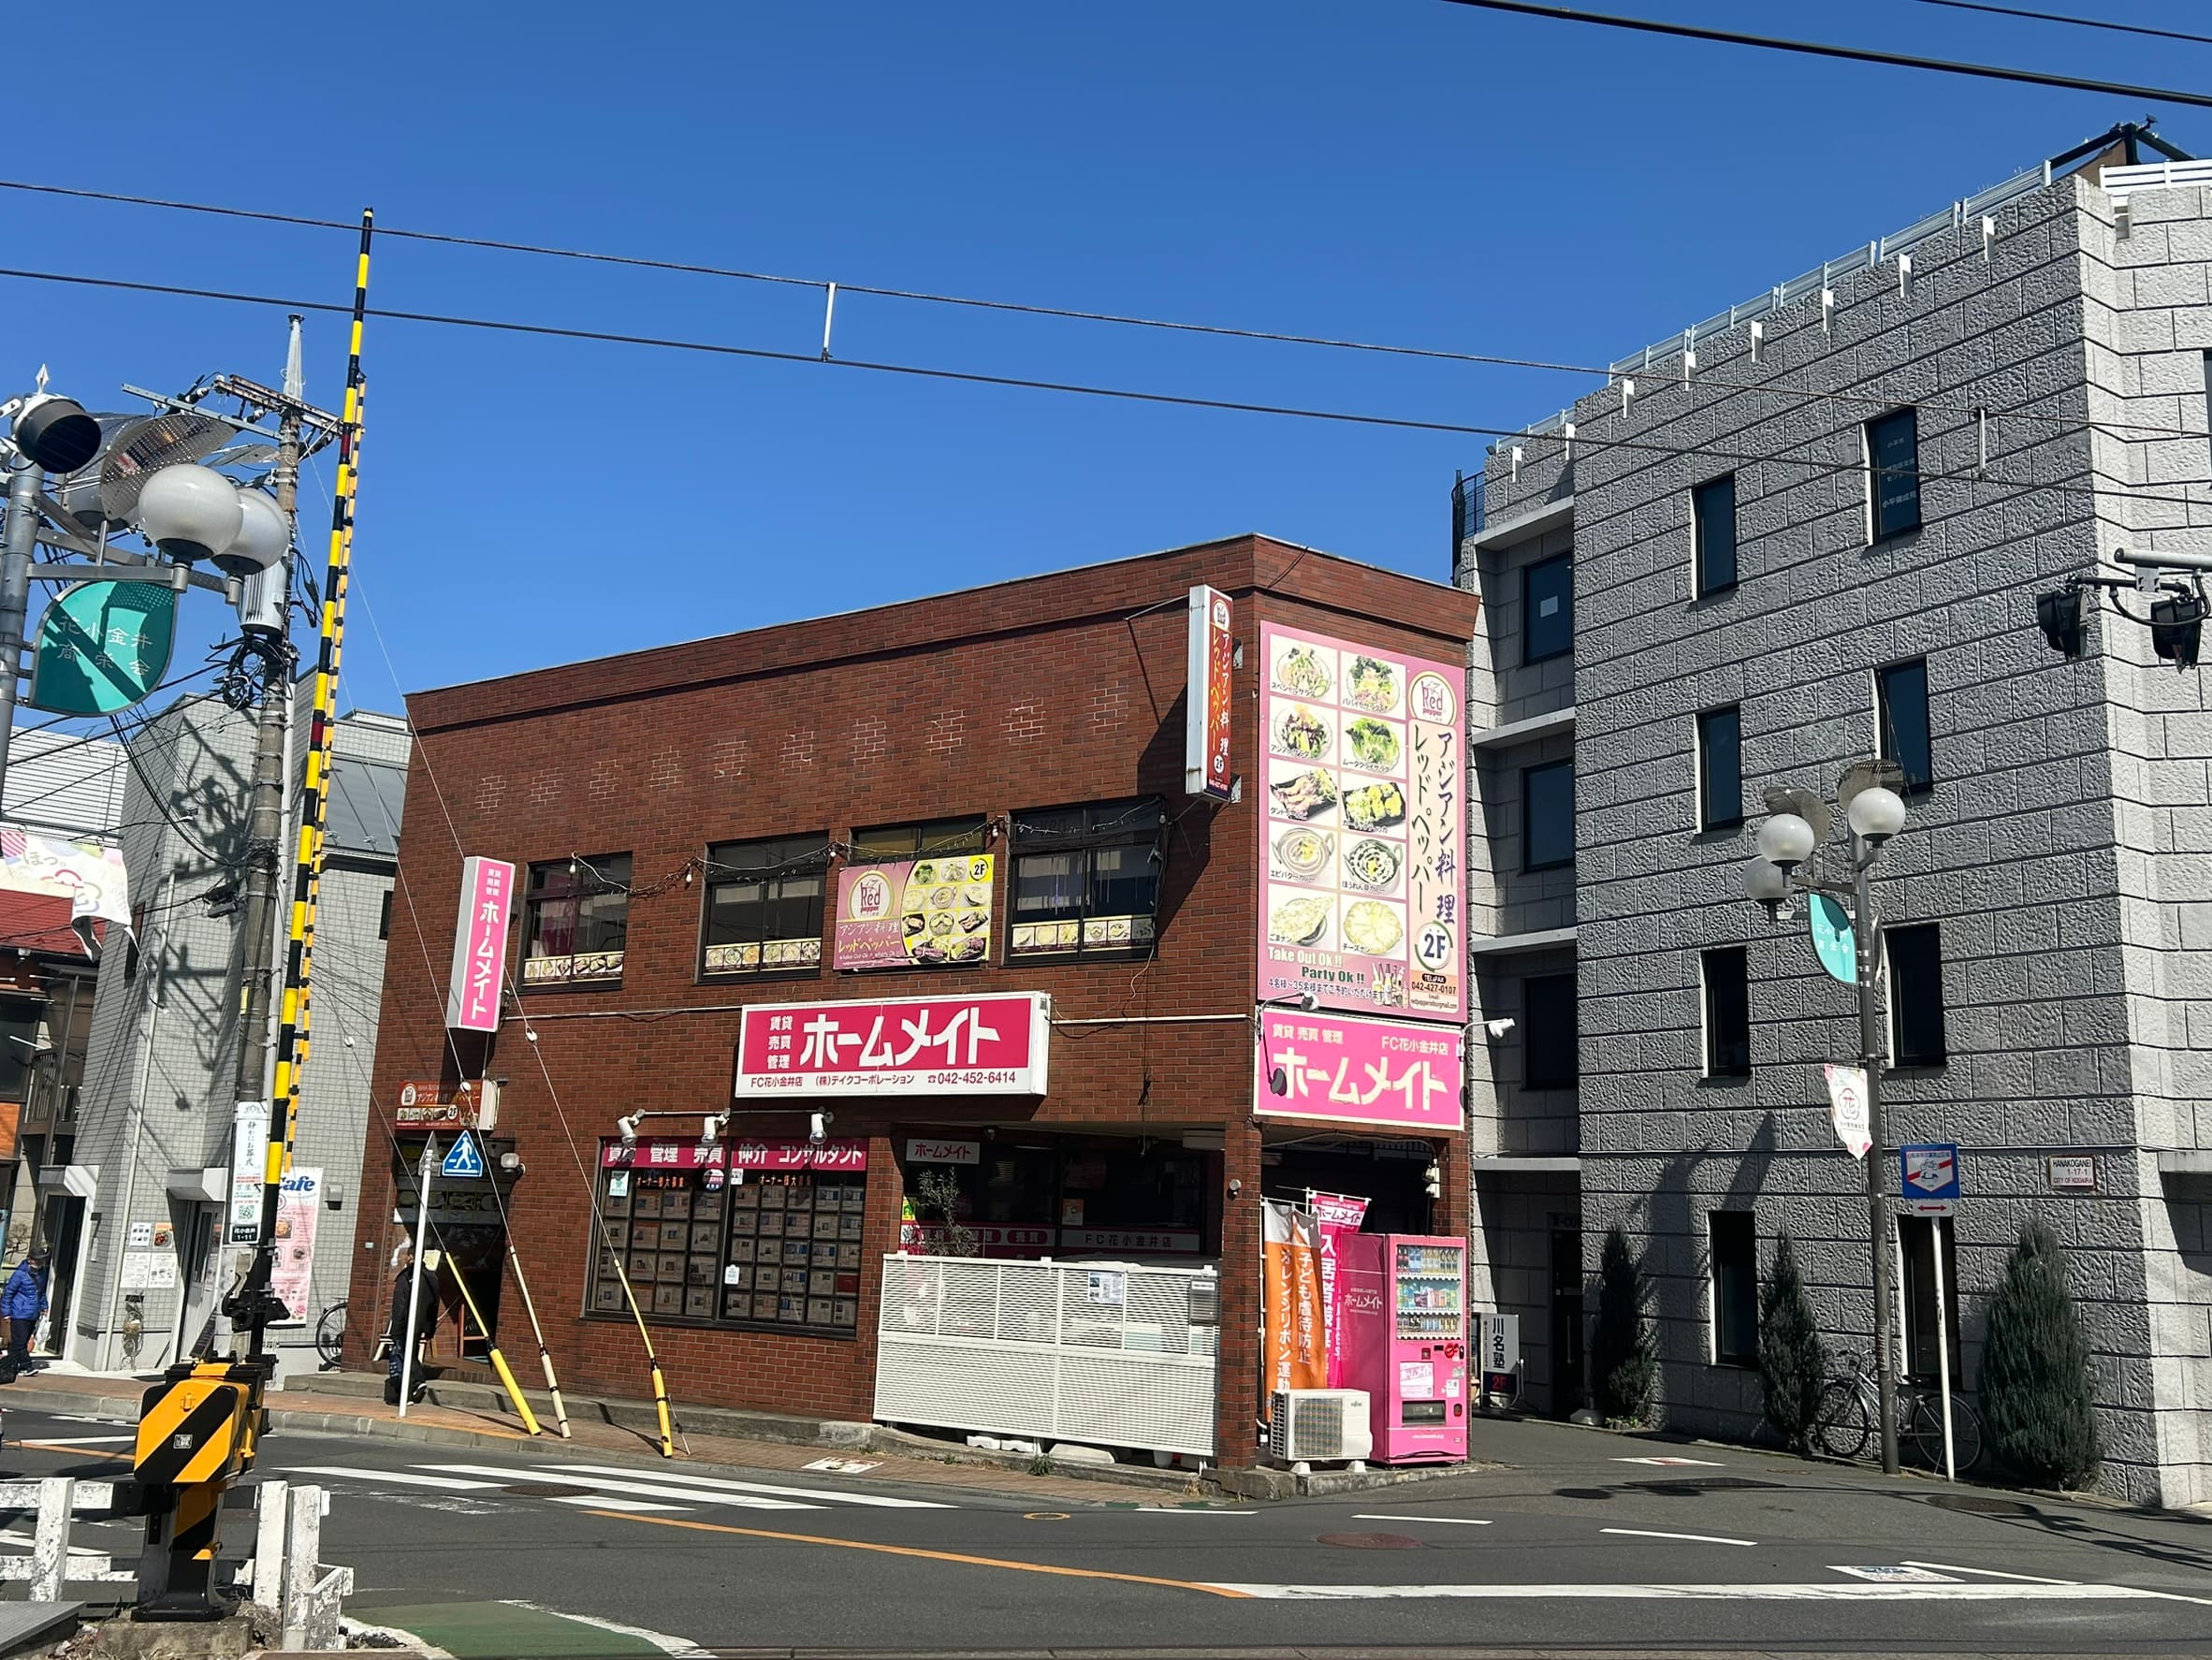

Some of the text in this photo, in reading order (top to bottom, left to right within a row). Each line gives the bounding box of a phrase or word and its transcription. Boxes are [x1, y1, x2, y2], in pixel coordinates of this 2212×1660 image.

[59, 615, 153, 649] 花小金井
[57, 643, 151, 676] 商栄会
[1209, 628, 1220, 751] レッドペッパー
[1219, 633, 1230, 757] アジアン料理
[1421, 680, 1444, 711] Red
[1422, 707, 1443, 717] pepper
[1215, 757, 1223, 771] 2F
[1411, 723, 1433, 914] レッドペッパー
[1435, 732, 1456, 925] アジアン料理
[974, 864, 985, 876] 2F
[860, 881, 881, 907] Red
[860, 906, 880, 914] pepper
[839, 921, 899, 937] アジアン料理
[838, 936, 900, 954] レッドペッパー
[1423, 933, 1447, 960] 2F
[471, 900, 500, 1020] ホームメイト
[1267, 946, 1295, 963] Take
[1297, 950, 1317, 965] Out
[1318, 953, 1334, 967] Ok
[1302, 966, 1335, 982] Party
[1338, 970, 1354, 983] Ok
[1411, 981, 1457, 995] 042-427-0107
[770, 1015, 793, 1030] 賃貸
[768, 1035, 791, 1050] 売買
[799, 1007, 1001, 1069] ホームメイト
[1273, 1024, 1344, 1044] 賃貸 売買 管理
[1381, 1036, 1448, 1056] FC花小金井店
[767, 1055, 790, 1070] 管理
[750, 1076, 803, 1088] FC花小金井店
[815, 1073, 914, 1086] (株)テイクコーポレーション
[938, 1070, 1016, 1085] 042-452-6414
[1273, 1046, 1448, 1112] ホームメイト
[449, 1107, 457, 1116] 2F
[650, 1143, 678, 1163] 管理
[693, 1143, 723, 1164] 売買
[738, 1143, 768, 1164] 仲介
[779, 1143, 862, 1164] コンサルタント
[915, 1143, 971, 1159] ホームメイト
[2067, 1168, 2088, 1176] 1-17-1
[1085, 1234, 1171, 1247] FC花小金井店
[1298, 1251, 1312, 1365] 子ども虐待防止
[1344, 1293, 1383, 1310] ホームメイト
[1277, 1249, 1292, 1391] オレンジリボン運動
[1492, 1317, 1505, 1369] 川名塾
[1492, 1376, 1507, 1391] 2F
